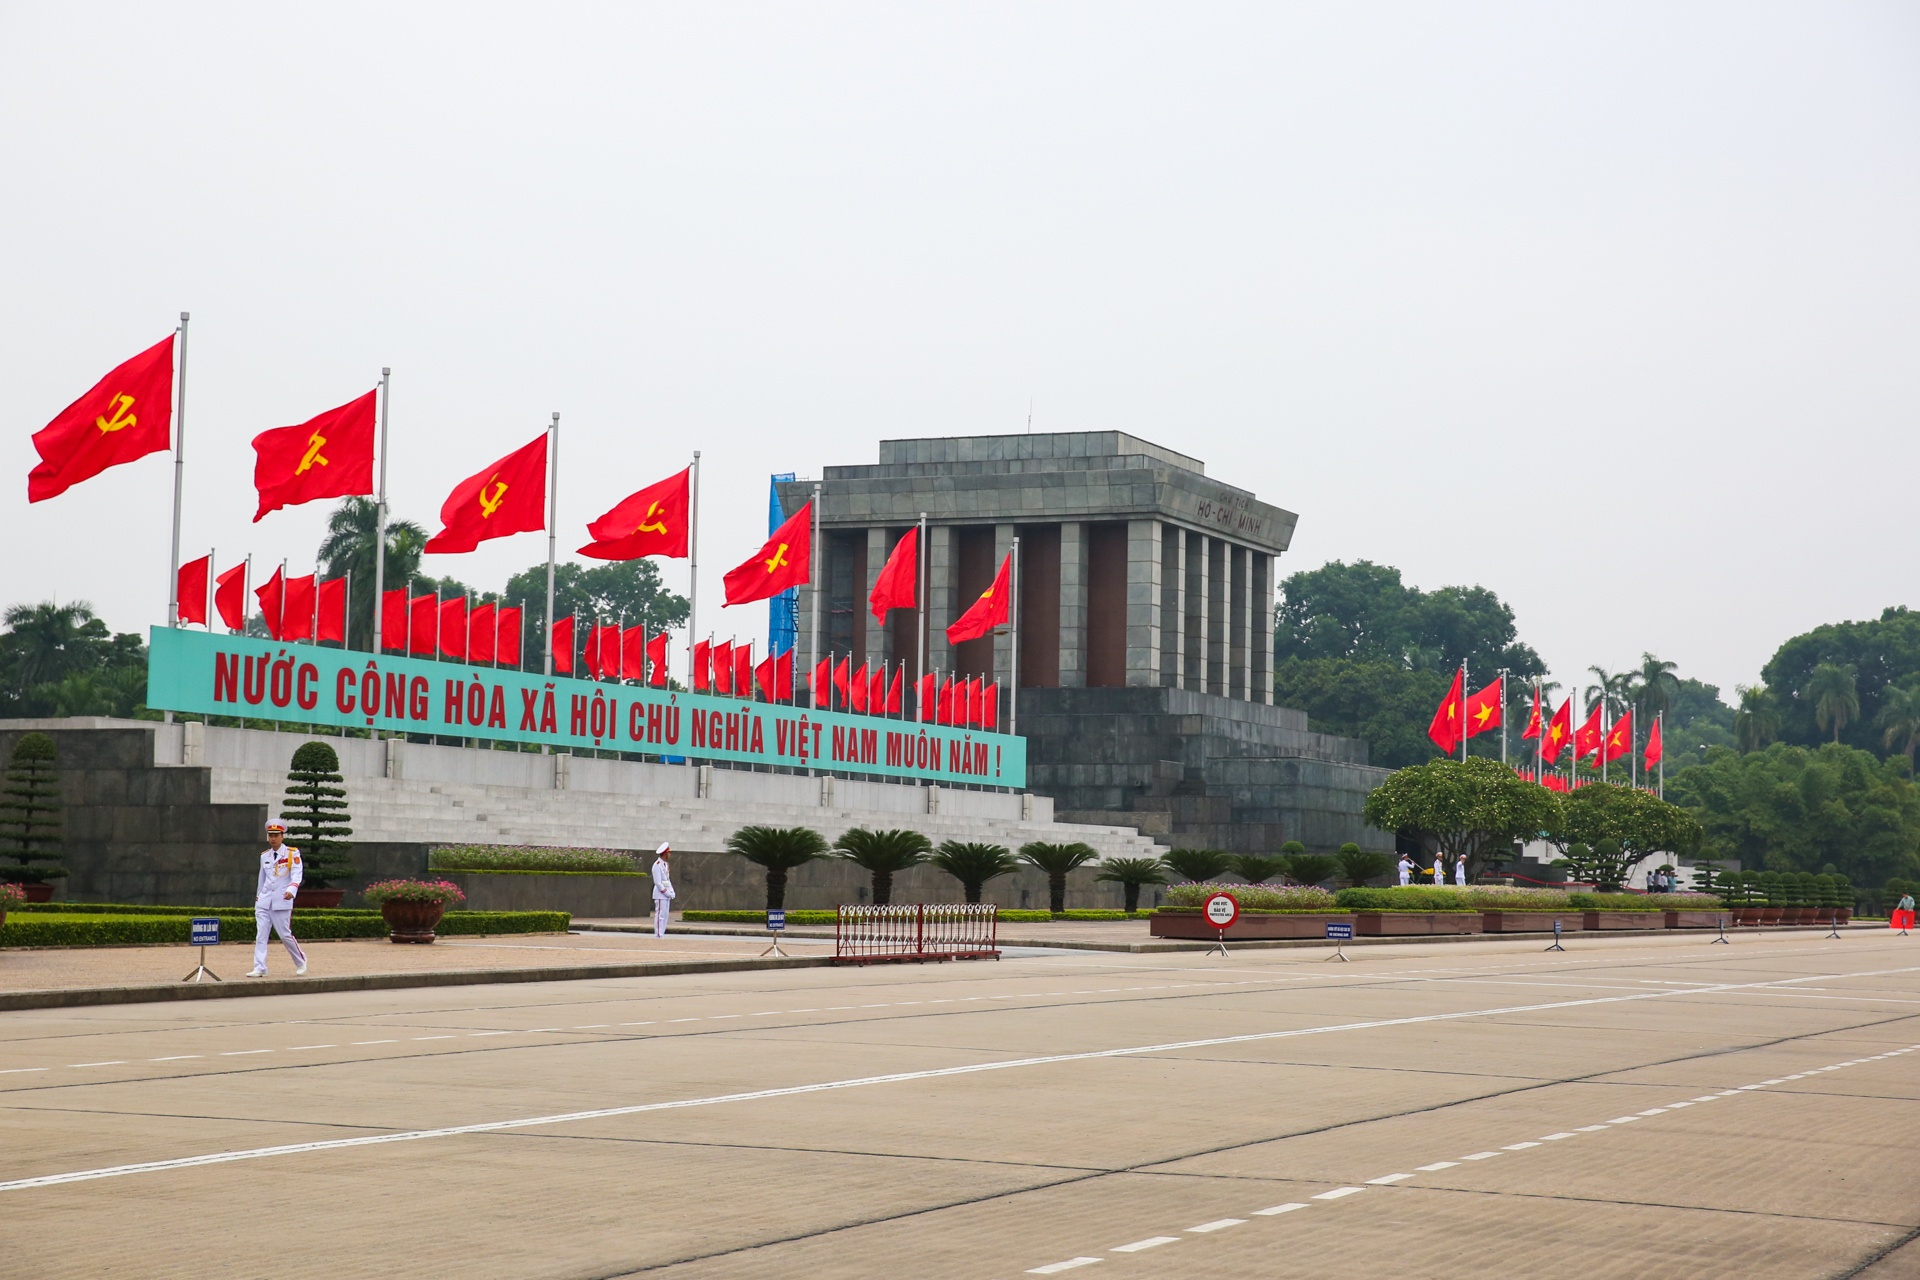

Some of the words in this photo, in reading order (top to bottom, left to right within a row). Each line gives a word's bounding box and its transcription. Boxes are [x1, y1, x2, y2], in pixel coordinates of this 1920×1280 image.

[1238, 514, 1261, 534] MINH
[214, 649, 318, 710] NƯỚC
[336, 660, 429, 725] CỘNG
[444, 673, 507, 729] HÒA
[520, 682, 558, 733] XÃ
[571, 688, 617, 746] HỘI
[629, 693, 680, 746] CHỦ
[691, 706, 764, 754] NGHĨA
[776, 714, 822, 765] VIỆT
[832, 725, 877, 765] NAM
[886, 729, 941, 771] MUÔN
[949, 733, 988, 776] NĂM
